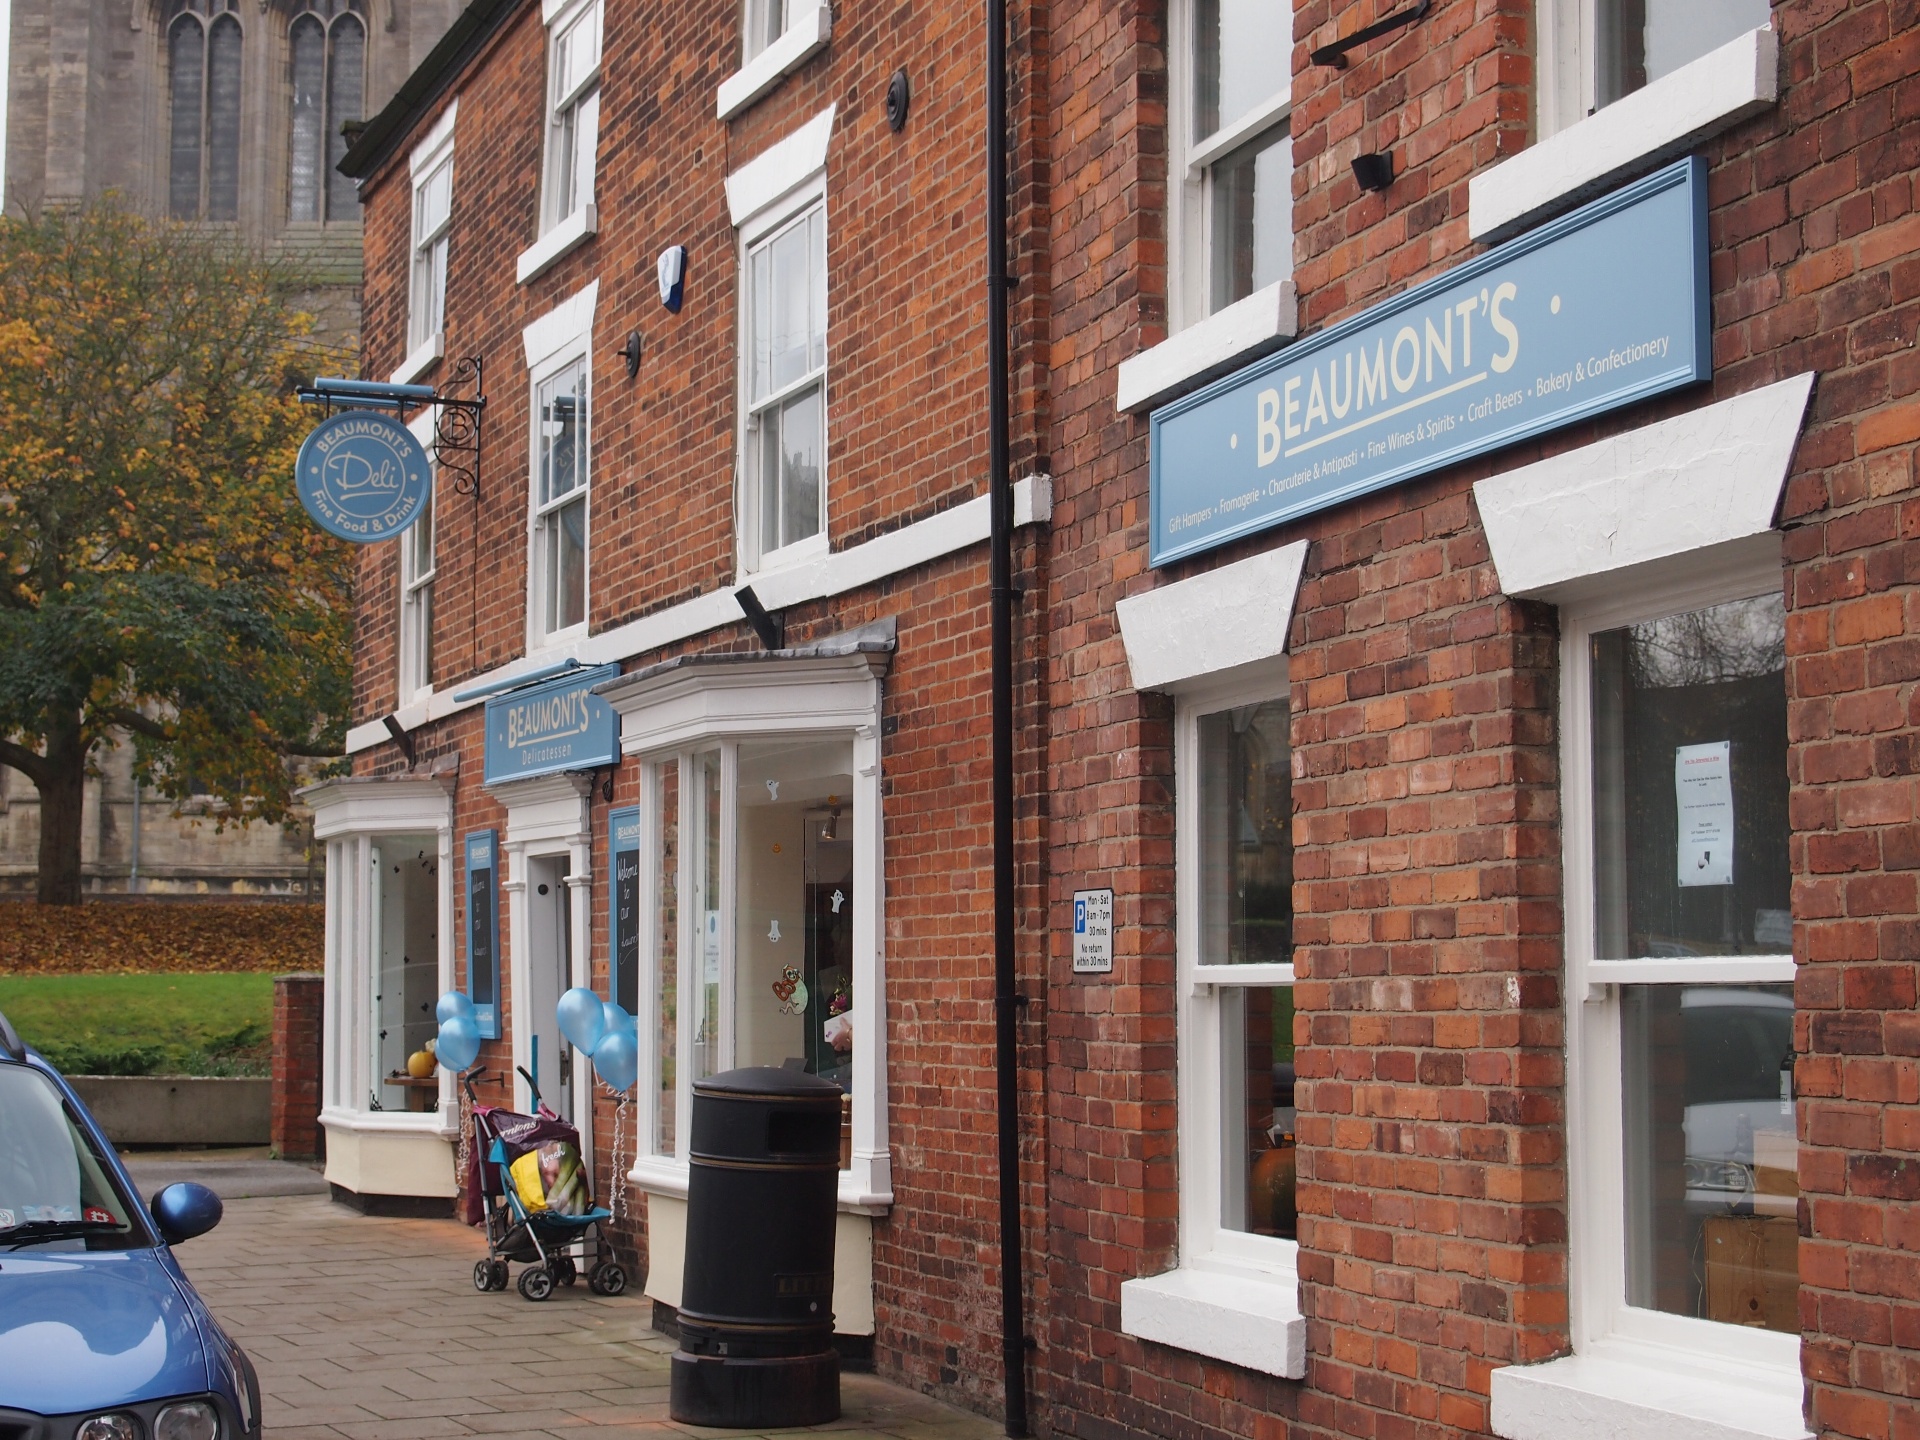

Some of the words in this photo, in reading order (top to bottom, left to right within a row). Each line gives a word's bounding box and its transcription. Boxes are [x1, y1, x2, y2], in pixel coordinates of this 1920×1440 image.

[1257, 282, 1518, 467] BEAUMONT'S
[316, 421, 412, 458] BEAUMONT'S
[1169, 516, 1181, 533] Gift
[1183, 507, 1212, 528] Hampers
[1220, 488, 1259, 514] Fromagerie
[1268, 468, 1312, 496] Charcuterie
[1313, 463, 1320, 479] &
[1321, 449, 1358, 476] Antipasti
[1368, 441, 1386, 459] Fine
[1388, 431, 1415, 454] Wines
[1416, 423, 1424, 440] &
[1426, 415, 1455, 440] Spirits
[1467, 397, 1493, 422] Craft
[1495, 389, 1522, 412] Beers
[1536, 370, 1573, 397] Bakery
[1575, 362, 1585, 382] &
[1587, 336, 1669, 377] Confectionery
[328, 451, 399, 490] Deli
[312, 489, 333, 518] Fine
[335, 514, 368, 532] Food
[372, 519, 383, 532] &
[384, 496, 416, 527] Drink
[508, 688, 589, 748] BEAUMONT'S
[522, 744, 572, 765] Delicatessen
[617, 857, 638, 881] Welcome
[1096, 926, 1107, 936] mins
[1076, 956, 1089, 966] within
[1090, 955, 1096, 966] 30
[1097, 956, 1108, 966] mins
[1081, 943, 1087, 953] No
[1088, 943, 1102, 953] return
[541, 1144, 565, 1168] fresh
